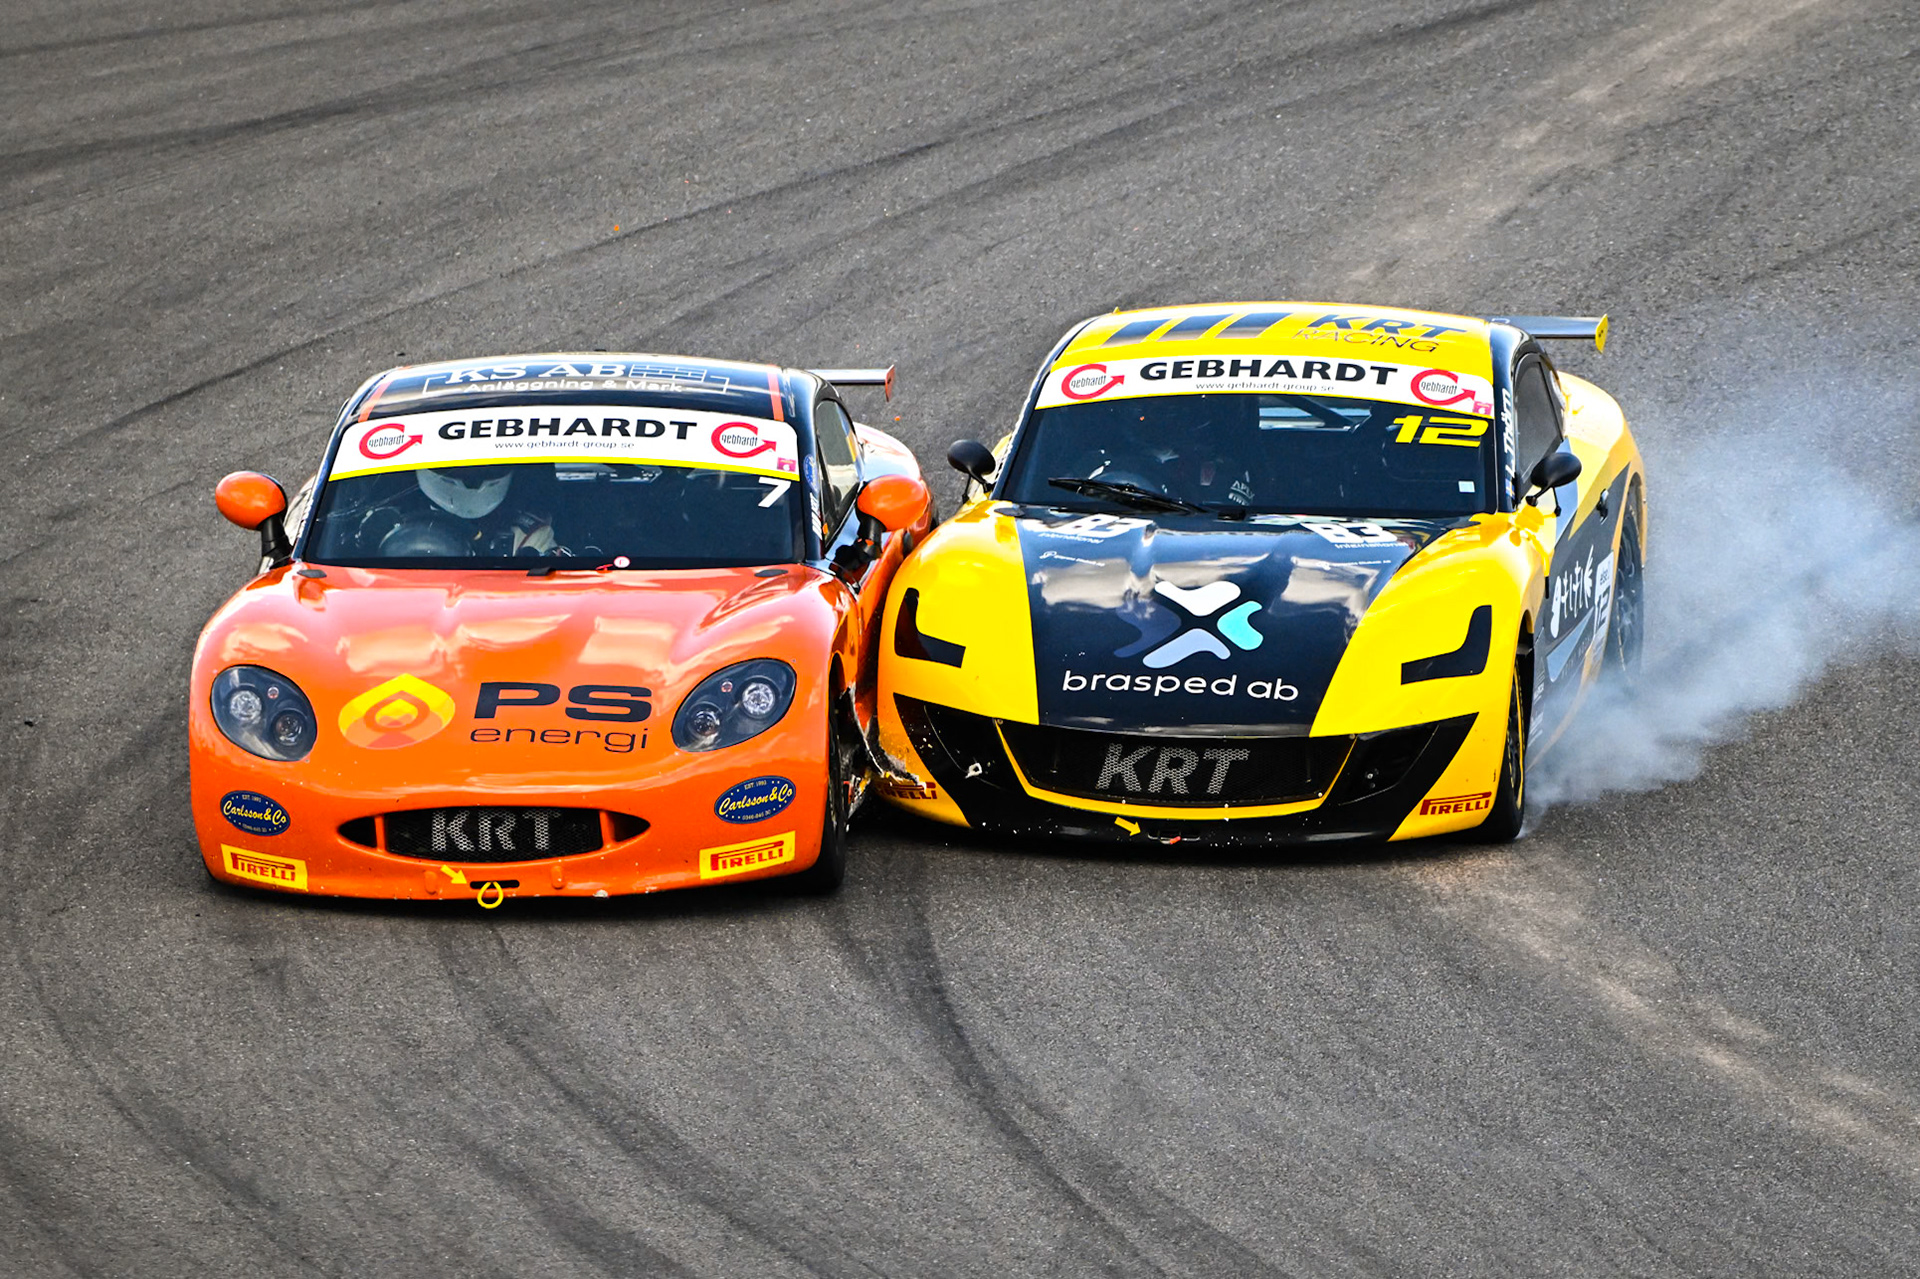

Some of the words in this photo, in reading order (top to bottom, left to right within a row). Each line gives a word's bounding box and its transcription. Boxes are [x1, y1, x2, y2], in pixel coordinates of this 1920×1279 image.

[1307, 314, 1468, 338] KRT
[1291, 329, 1440, 353] RACING
[445, 364, 527, 384] KS
[537, 362, 627, 379] AB
[1070, 375, 1107, 389] gebhardt
[1139, 359, 1399, 386] GEBHARDT
[464, 379, 594, 393] Anläggning
[602, 378, 617, 390] &
[625, 380, 683, 393] Mark
[1420, 380, 1458, 396] gebhardt
[368, 434, 405, 449] gebhardt
[437, 417, 698, 441] GEBHARDT
[721, 433, 759, 447] gebhardt
[1392, 414, 1490, 448] 12
[757, 476, 792, 508] 7
[1062, 669, 1238, 697] brasped
[1246, 678, 1300, 701] ab
[473, 681, 653, 723] PS
[470, 727, 649, 753] energi
[1094, 743, 1251, 795] KRT
[1419, 791, 1492, 816] PIRELLI
[431, 809, 562, 851] KRT
[230, 851, 296, 882] PIRELLI
[710, 840, 785, 871] PIRELLI
